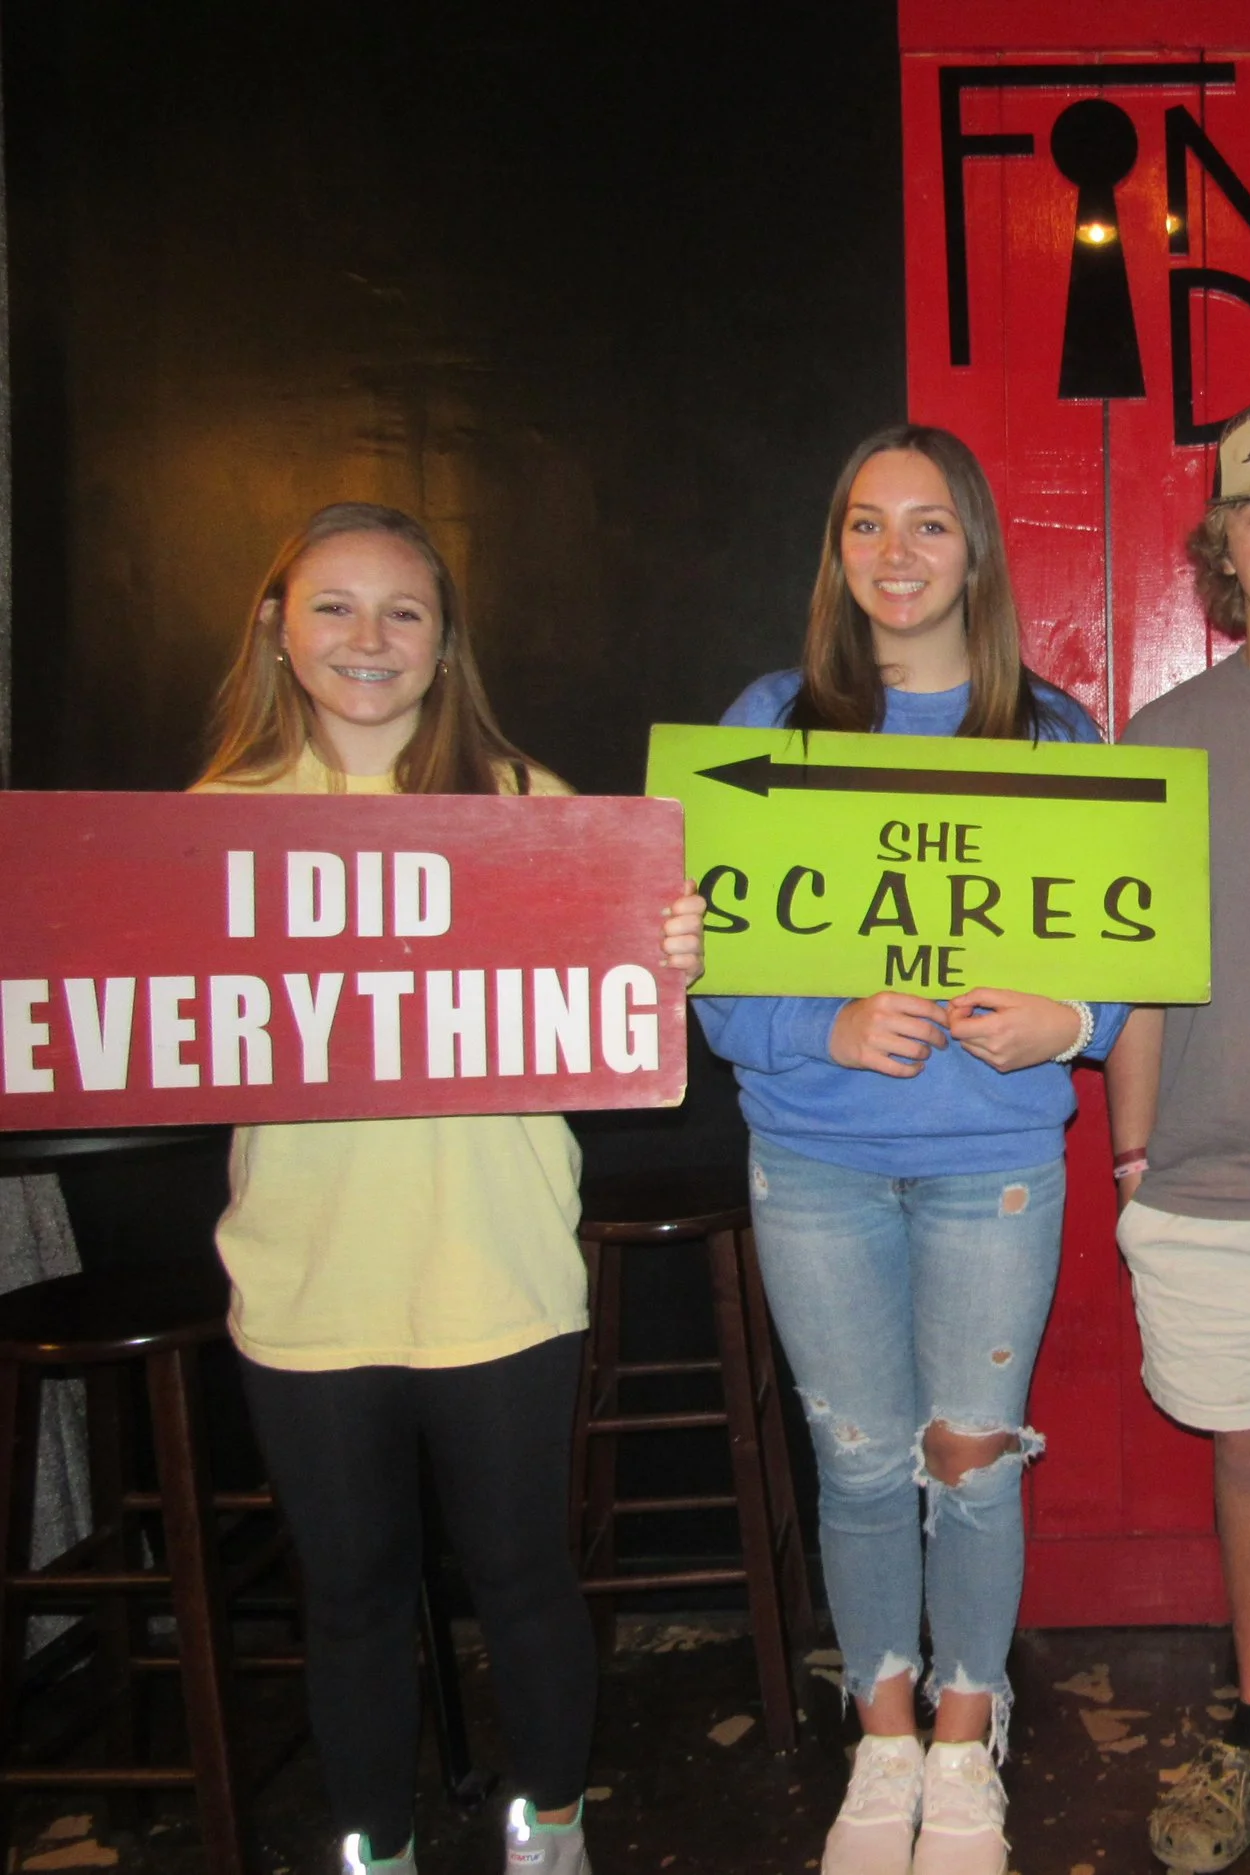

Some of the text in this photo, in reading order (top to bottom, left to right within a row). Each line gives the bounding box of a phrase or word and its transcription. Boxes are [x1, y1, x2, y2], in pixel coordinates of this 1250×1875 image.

[877, 820, 982, 863] SHE
[226, 850, 452, 938] I DID
[699, 864, 1156, 942] SCARES
[884, 944, 967, 988] ME
[2, 964, 659, 1094] EVERYTHING
